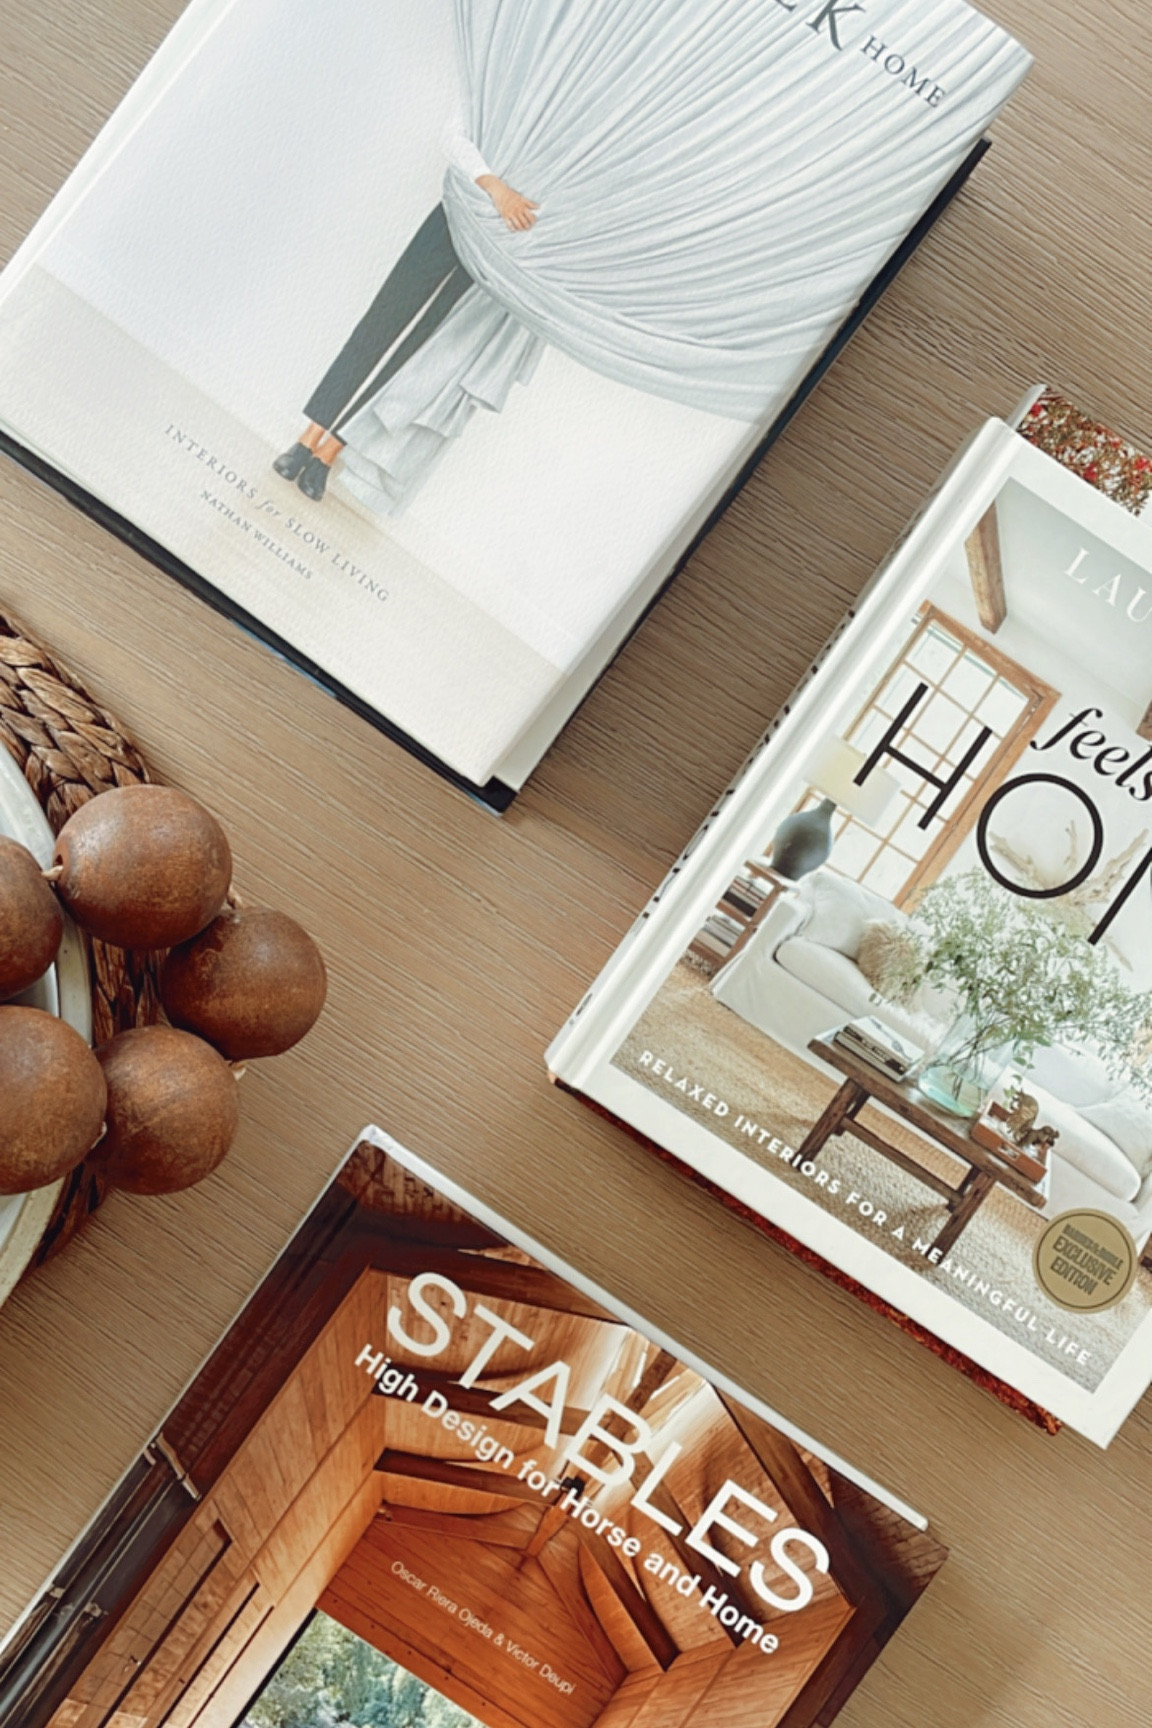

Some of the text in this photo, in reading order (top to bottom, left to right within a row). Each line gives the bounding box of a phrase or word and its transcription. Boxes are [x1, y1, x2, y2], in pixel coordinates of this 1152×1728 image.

[860, 36, 947, 108] HOME
[165, 424, 390, 602] INTERIORS for SLOW LIVING
[200, 490, 314, 580] NATHAN WILLIAMS
[853, 682, 1152, 946] HO
[639, 1050, 729, 1117] RELAXED
[734, 1115, 841, 1194] INTERIORS
[845, 1191, 888, 1227] FOR
[891, 1226, 905, 1241] A
[911, 1237, 1038, 1332] MEANINGFUL
[1045, 1327, 1092, 1366] LIFE
[1050, 1255, 1099, 1296] EDITION
[1053, 1235, 1117, 1286] EXCLUSIVE
[354, 1343, 780, 1655] High Design for Horse and Home
[386, 1272, 830, 1613] STABLES
[391, 1561, 577, 1695] Oscar Riera Ojeda & Victor Deupi
